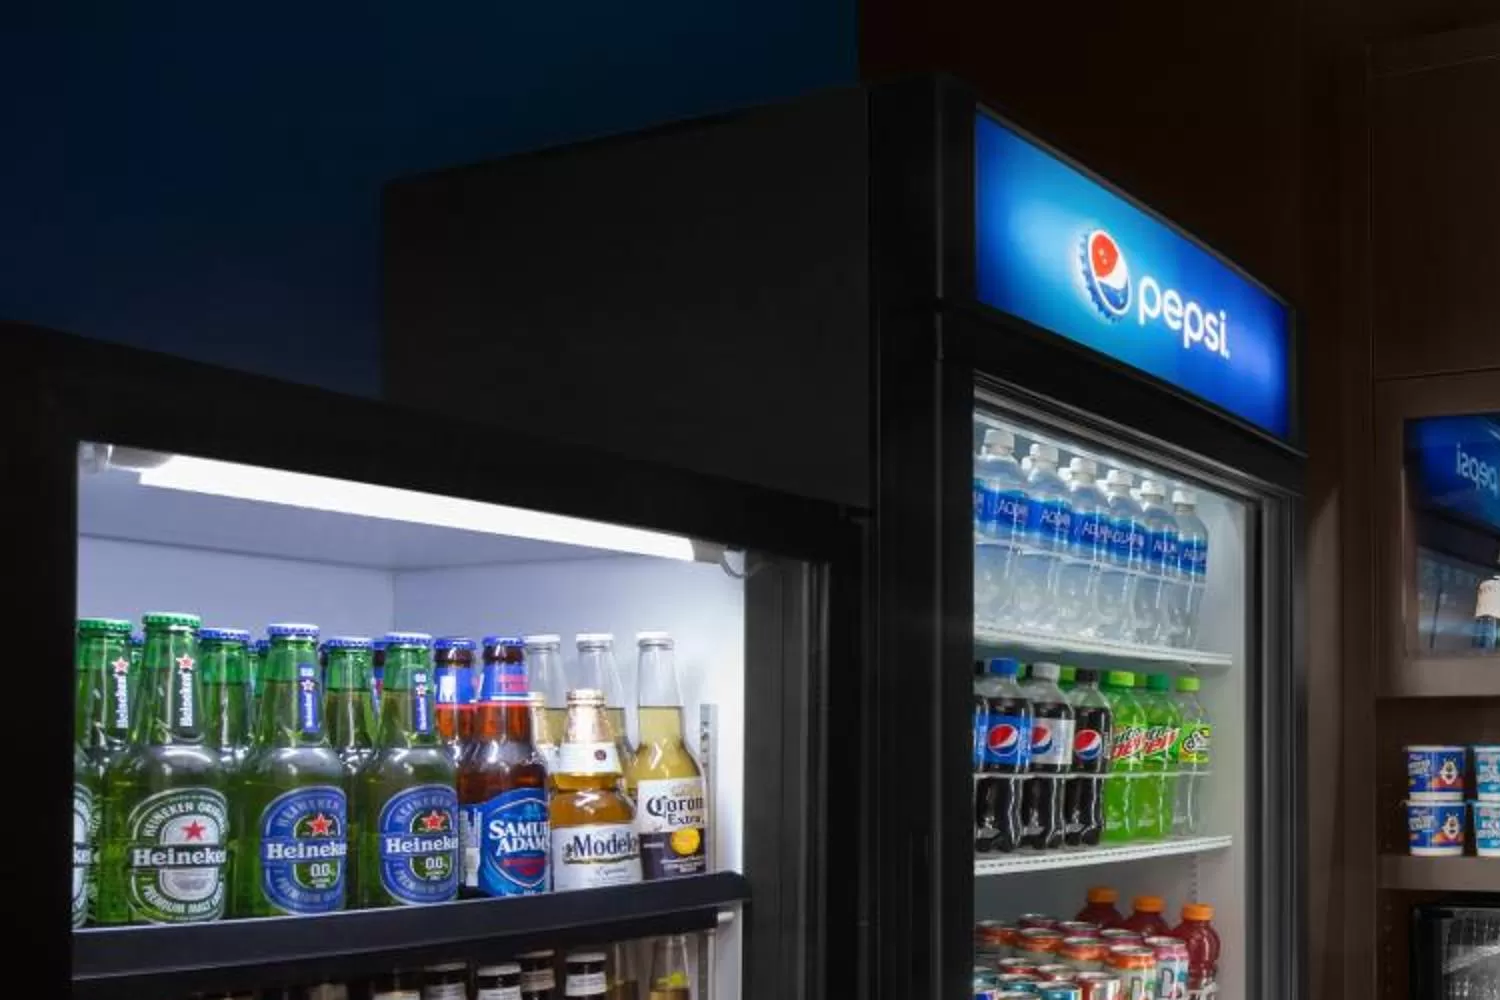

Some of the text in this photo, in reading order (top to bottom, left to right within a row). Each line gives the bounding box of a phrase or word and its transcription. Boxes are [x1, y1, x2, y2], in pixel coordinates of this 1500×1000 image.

[1138, 276, 1228, 358] pepsi
[646, 796, 704, 821] Coron
[488, 819, 549, 840] SAMU
[267, 842, 347, 860] Heinek
[385, 837, 459, 854] Heinek
[133, 847, 227, 865] Heineke
